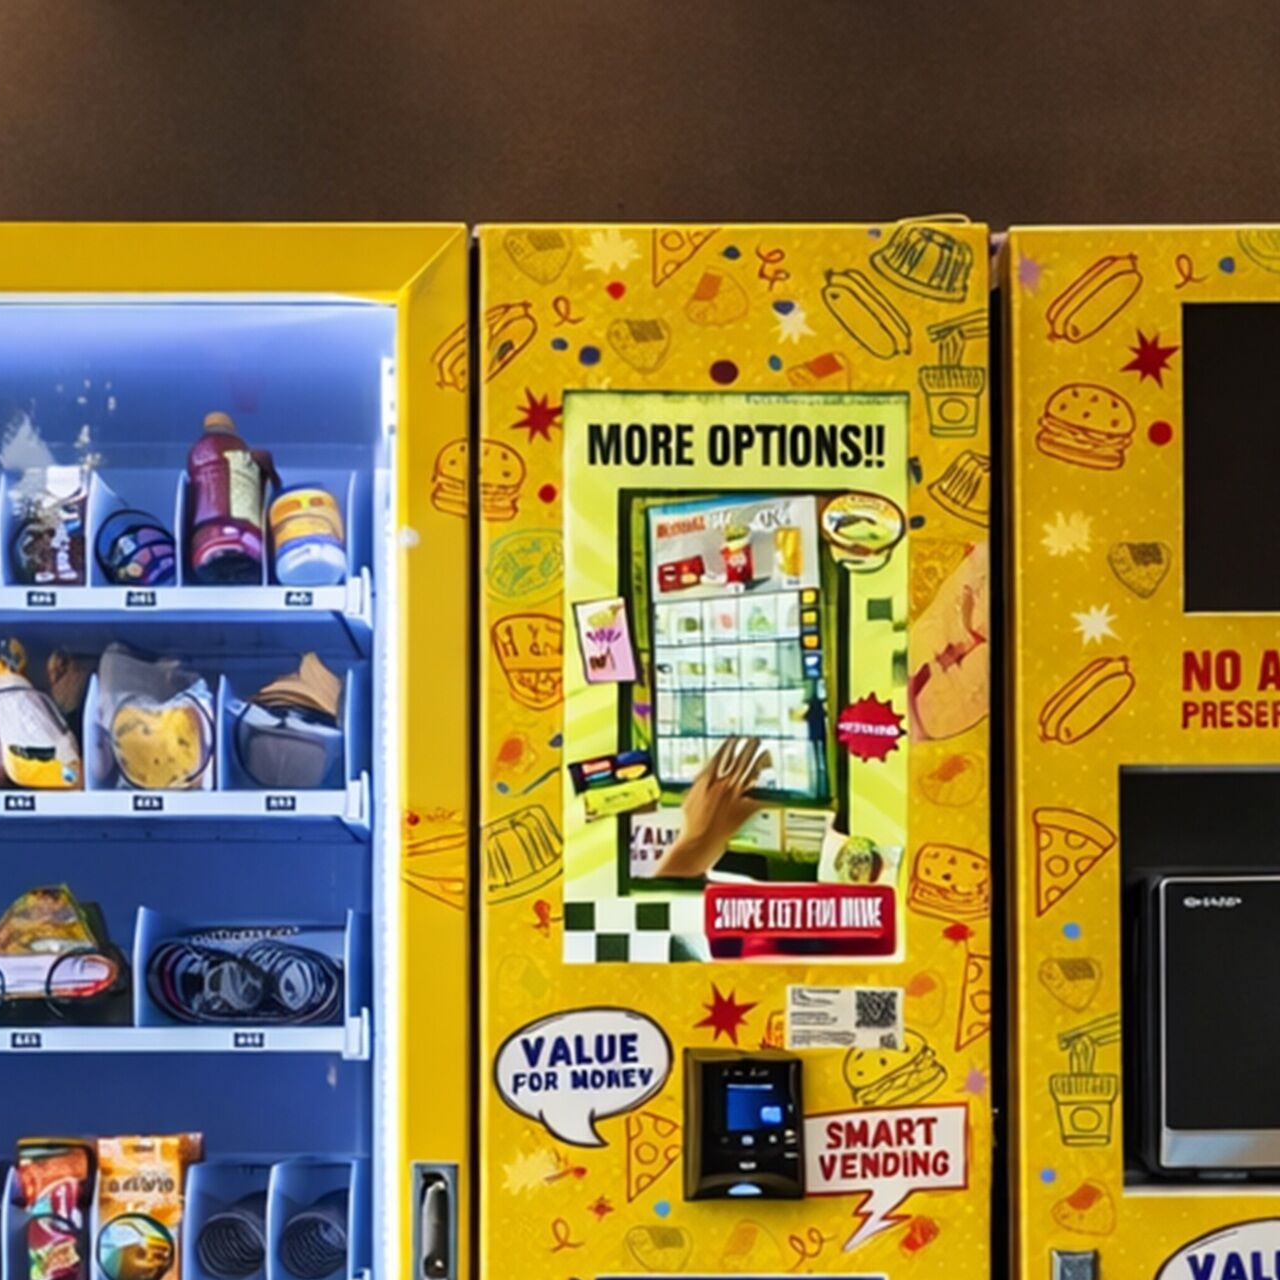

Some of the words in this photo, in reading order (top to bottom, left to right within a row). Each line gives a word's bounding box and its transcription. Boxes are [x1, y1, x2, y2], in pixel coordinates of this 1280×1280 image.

[587, 423, 694, 467] MORE
[707, 424, 886, 469] OPTIONS!!
[1182, 649, 1241, 692] NO
[521, 1033, 639, 1068] VALUE
[512, 1071, 559, 1095] FOR
[570, 1068, 654, 1090] MONEY
[826, 1117, 938, 1149] SMART
[819, 1150, 950, 1182] VENDING
